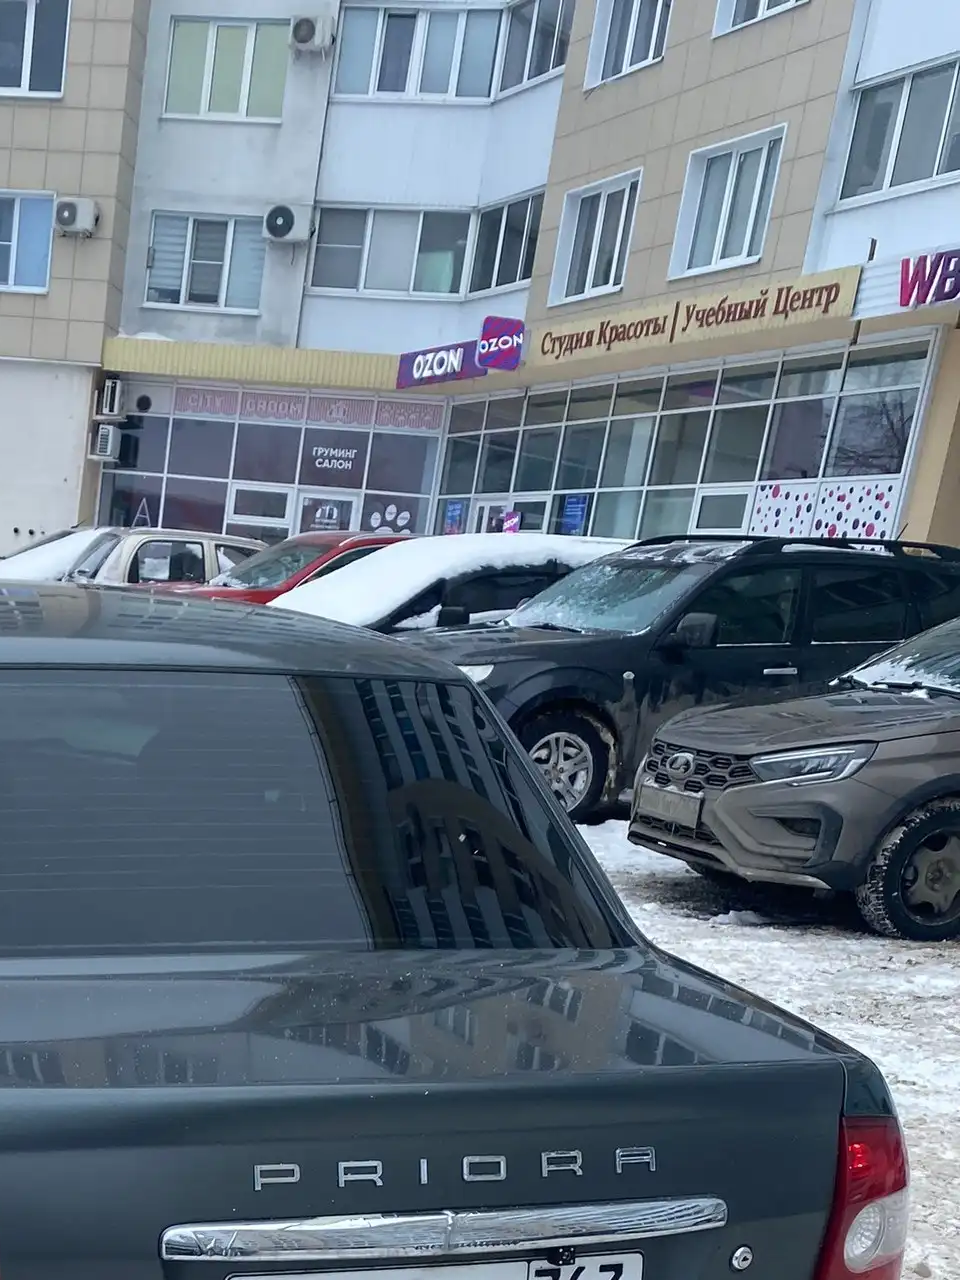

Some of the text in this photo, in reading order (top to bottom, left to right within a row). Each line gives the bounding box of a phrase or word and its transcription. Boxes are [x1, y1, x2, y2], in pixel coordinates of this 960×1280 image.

[900, 249, 960, 307] WB
[541, 282, 841, 359] Студия Красоты Учебный Центр
[480, 333, 524, 353] OZON
[412, 347, 464, 379] OZON
[188, 393, 302, 415] CITY GROOM
[312, 446, 358, 459] ГРУМИНГ
[315, 458, 353, 470] САЛОН
[253, 1146, 657, 1191] PRIORA
